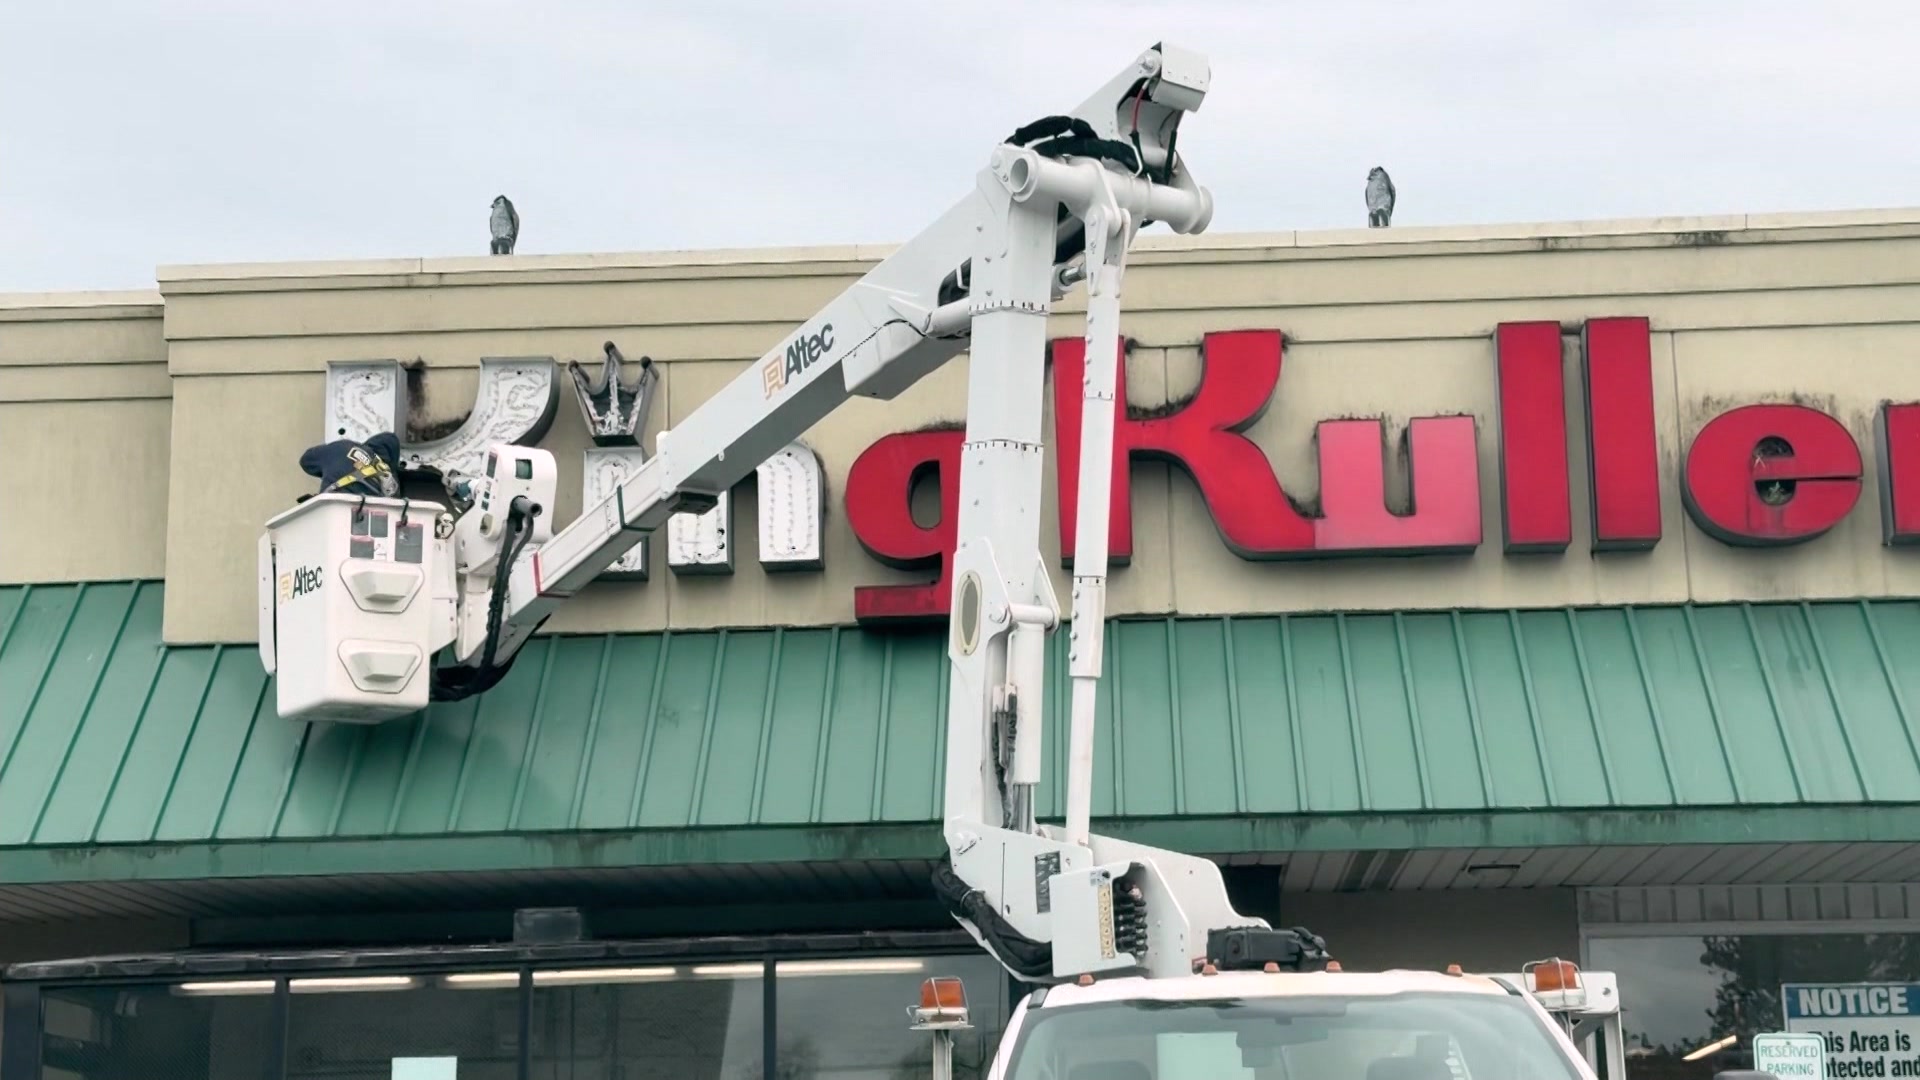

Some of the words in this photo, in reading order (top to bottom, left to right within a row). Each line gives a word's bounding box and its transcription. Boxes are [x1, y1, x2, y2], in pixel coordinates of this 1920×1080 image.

[784, 323, 834, 385] Altec
[1053, 317, 1920, 566] Kulle
[292, 565, 323, 600] Altec
[1798, 986, 1909, 1016] NOTICE
[1760, 1045, 1818, 1058] RESERVED
[1850, 1030, 1890, 1052] Area
[1895, 1029, 1911, 1051] is
[1766, 1063, 1814, 1076] PARKING
[1825, 1056, 1885, 1078] tected
